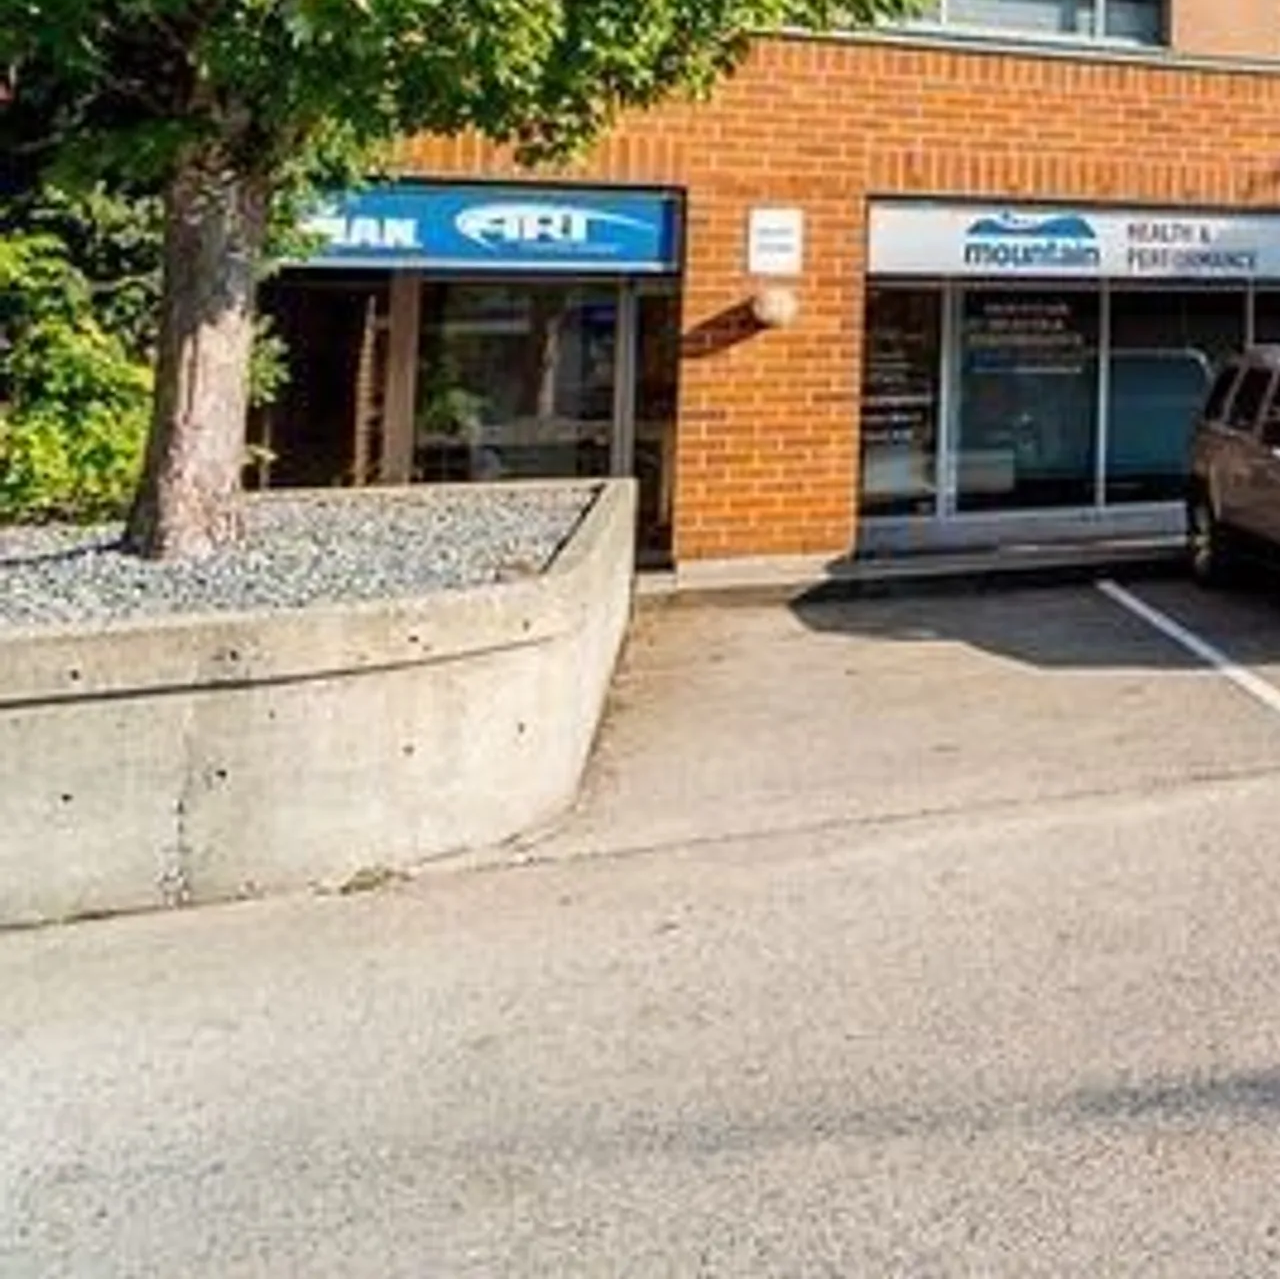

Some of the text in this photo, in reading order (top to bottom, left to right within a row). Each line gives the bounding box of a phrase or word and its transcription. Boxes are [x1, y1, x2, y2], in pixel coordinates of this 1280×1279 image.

[1127, 223, 1212, 243] HEALTH &
[964, 242, 1100, 267] mountain
[1127, 247, 1257, 270] PERFORMANCE
